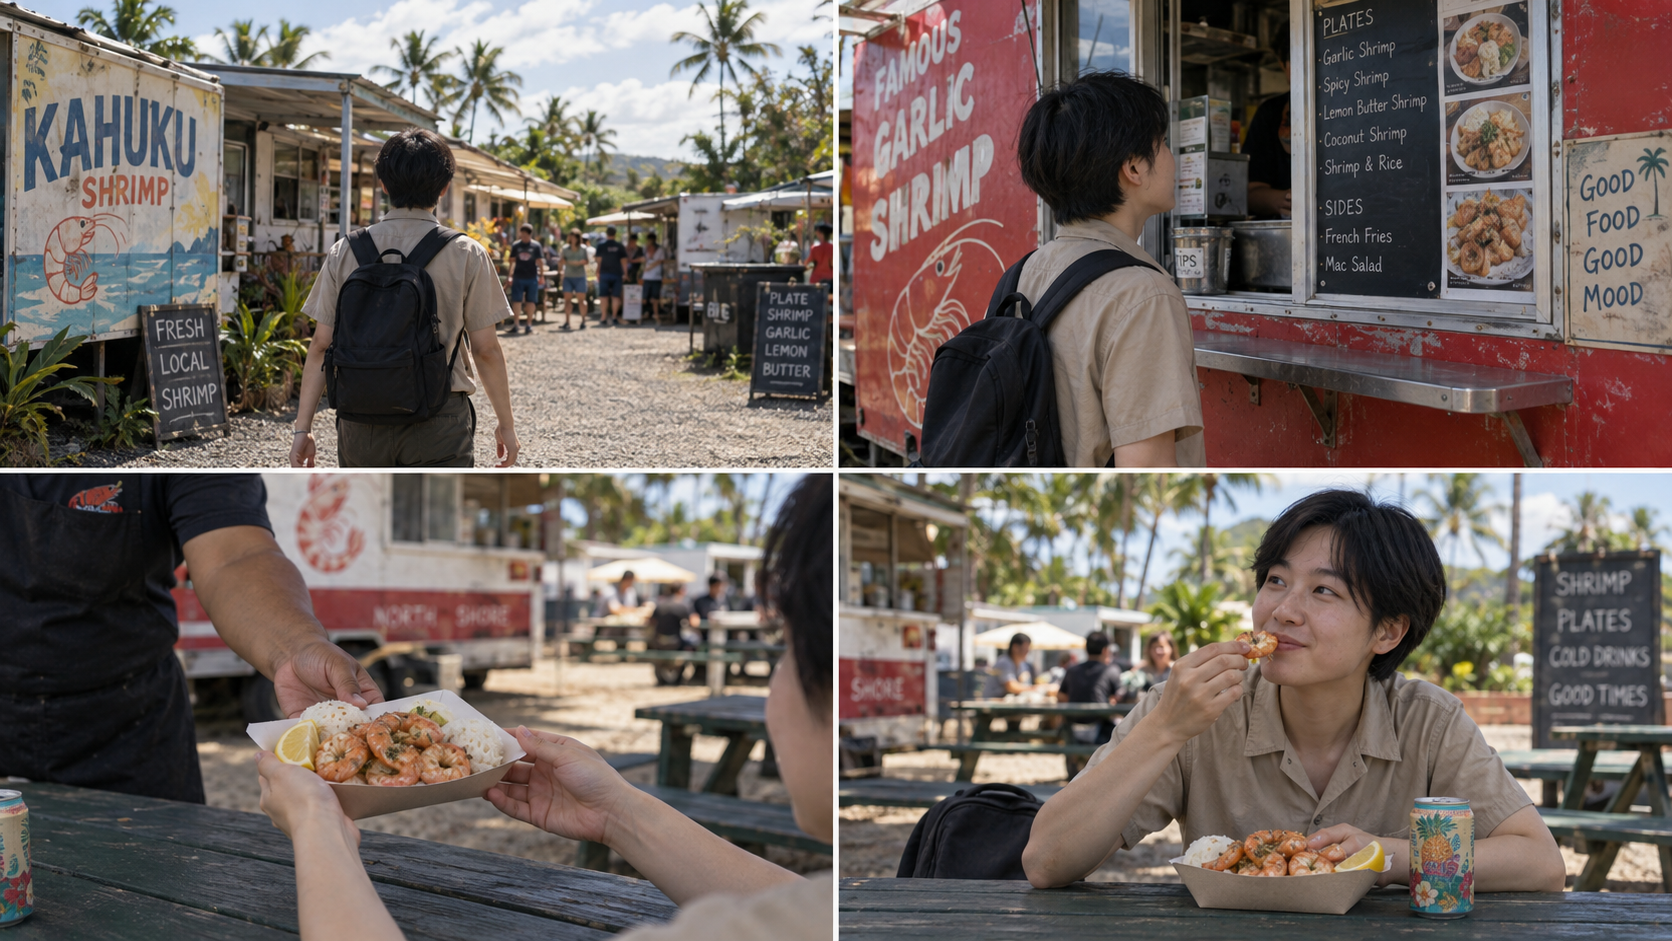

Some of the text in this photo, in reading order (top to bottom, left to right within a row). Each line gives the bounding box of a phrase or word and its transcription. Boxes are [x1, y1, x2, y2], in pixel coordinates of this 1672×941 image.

[1323, 8, 1374, 36] PLATES
[874, 10, 962, 111] FAMOUS
[1323, 39, 1396, 67] Garlic Shrimp
[1323, 69, 1389, 96] Spicy Shrimp
[873, 62, 975, 178] GARLIC
[1323, 94, 1427, 121] Lemon Butter Shrimp
[24, 95, 197, 193] KAHUKU
[1324, 127, 1407, 148] Coconut Shrimp
[1324, 156, 1403, 177] Shrimp & Rice
[82, 175, 169, 209] SHRIMP
[870, 133, 995, 262] SHRIMP
[1580, 169, 1635, 201] GOOD
[1324, 198, 1363, 217] SIDES
[1586, 206, 1640, 238] FOOD
[1325, 227, 1392, 244] French Fries
[1325, 257, 1382, 273] Mac Salad
[1583, 243, 1643, 275] GOOD
[769, 292, 808, 305] PLATE
[1583, 282, 1643, 313] MOOD
[767, 308, 813, 322] SHRIMP
[156, 318, 204, 342] FRESH
[765, 326, 811, 340] GARLIC
[160, 351, 209, 375] LOCAL
[765, 343, 808, 358] LEMON
[763, 362, 811, 378] BUTTER
[162, 383, 217, 411] SHRIMP
[1555, 570, 1633, 597] SHRIMP
[373, 604, 511, 627] NORTH SHORE
[1557, 608, 1633, 633] PLATES
[1549, 645, 1651, 668] COLD DRINKS
[850, 675, 905, 702] SHORE
[1549, 683, 1649, 707] GOOD TIMES
